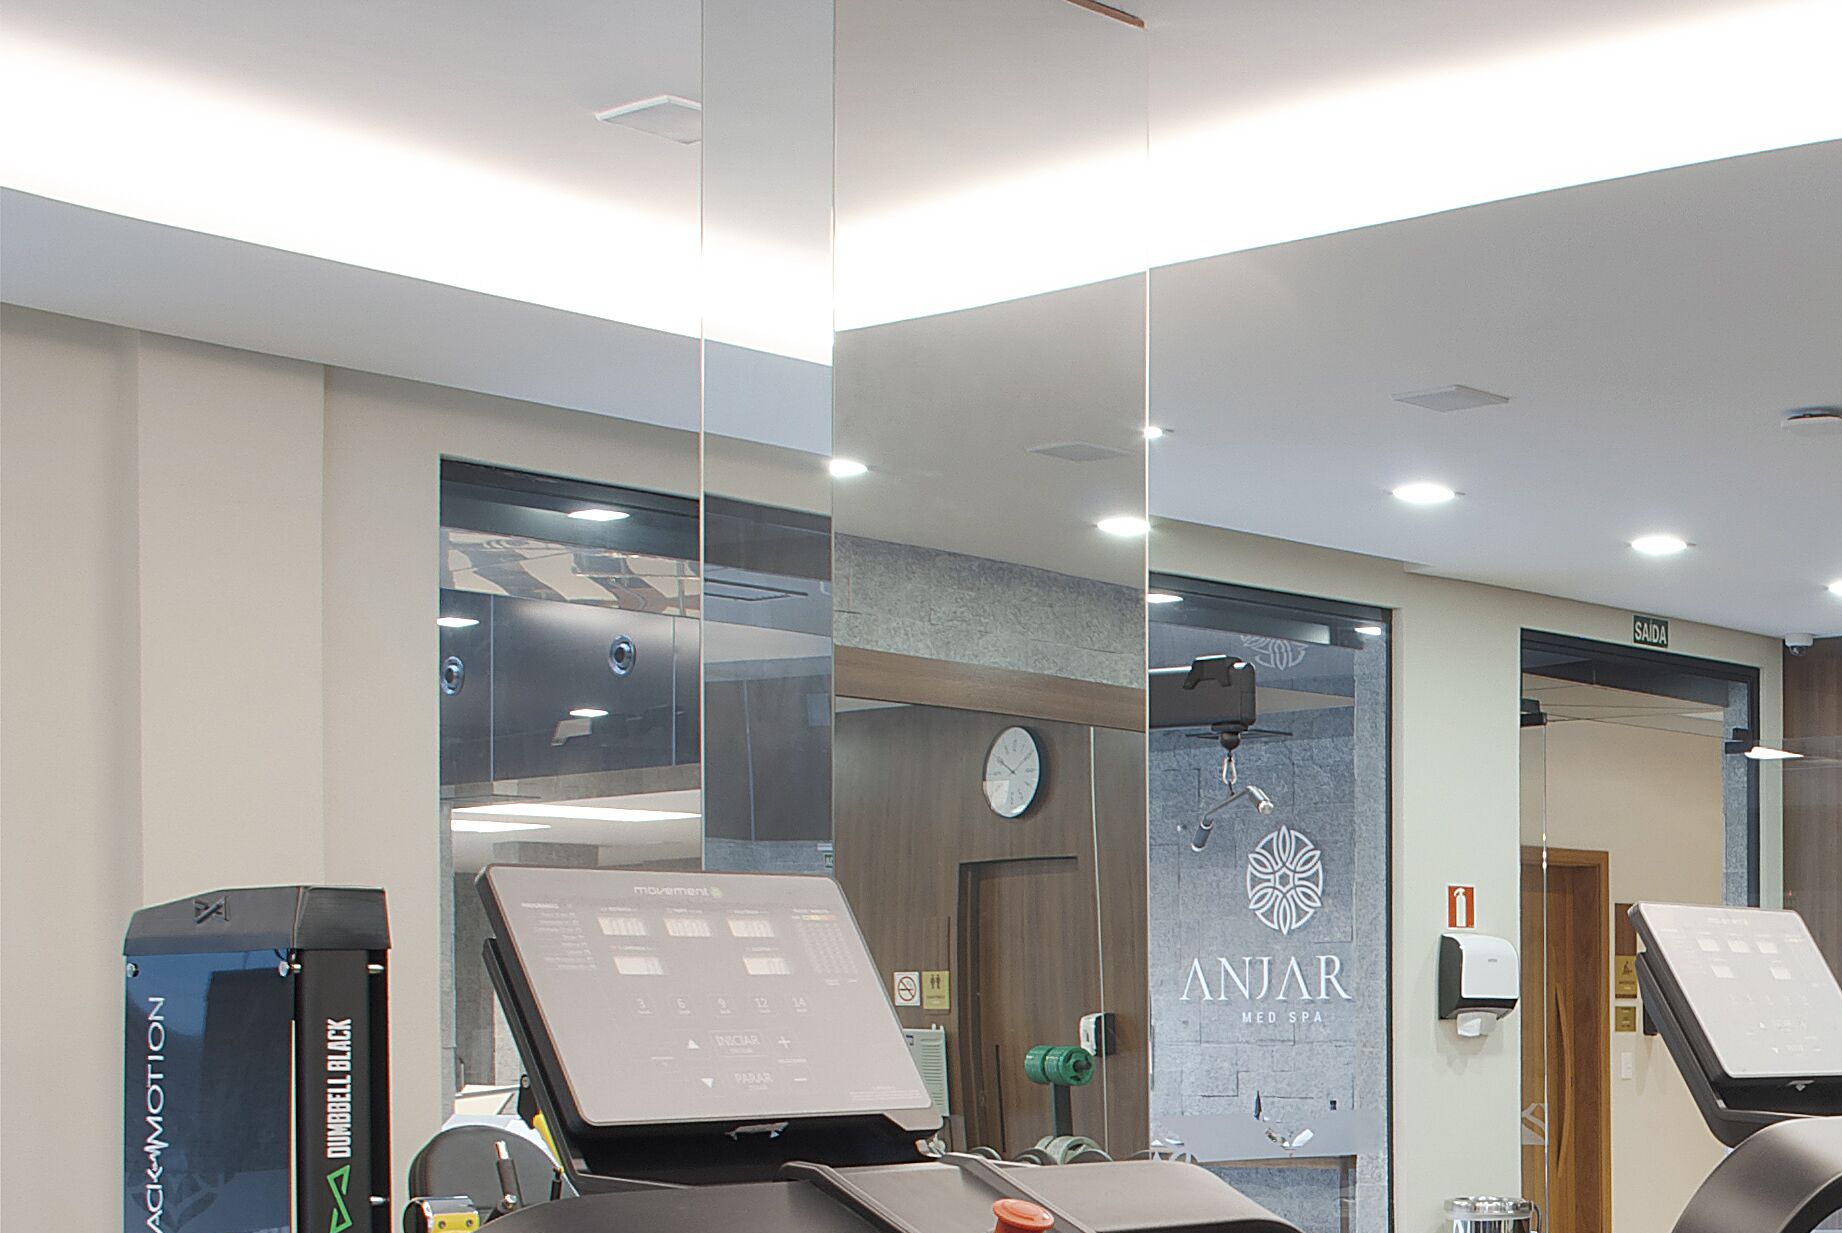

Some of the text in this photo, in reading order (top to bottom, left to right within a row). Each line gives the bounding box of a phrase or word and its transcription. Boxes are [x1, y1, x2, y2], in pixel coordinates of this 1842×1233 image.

[1634, 620, 1668, 645] SAÍDA
[633, 885, 710, 897] movement
[1179, 954, 1353, 1001] ANJAR
[754, 997, 769, 1008] 12
[1242, 1010, 1323, 1024] MED SPA
[714, 1035, 761, 1047] INICIAR
[734, 1072, 774, 1084] PARAR
[326, 1017, 352, 1159] DUMBBELL BLACK
